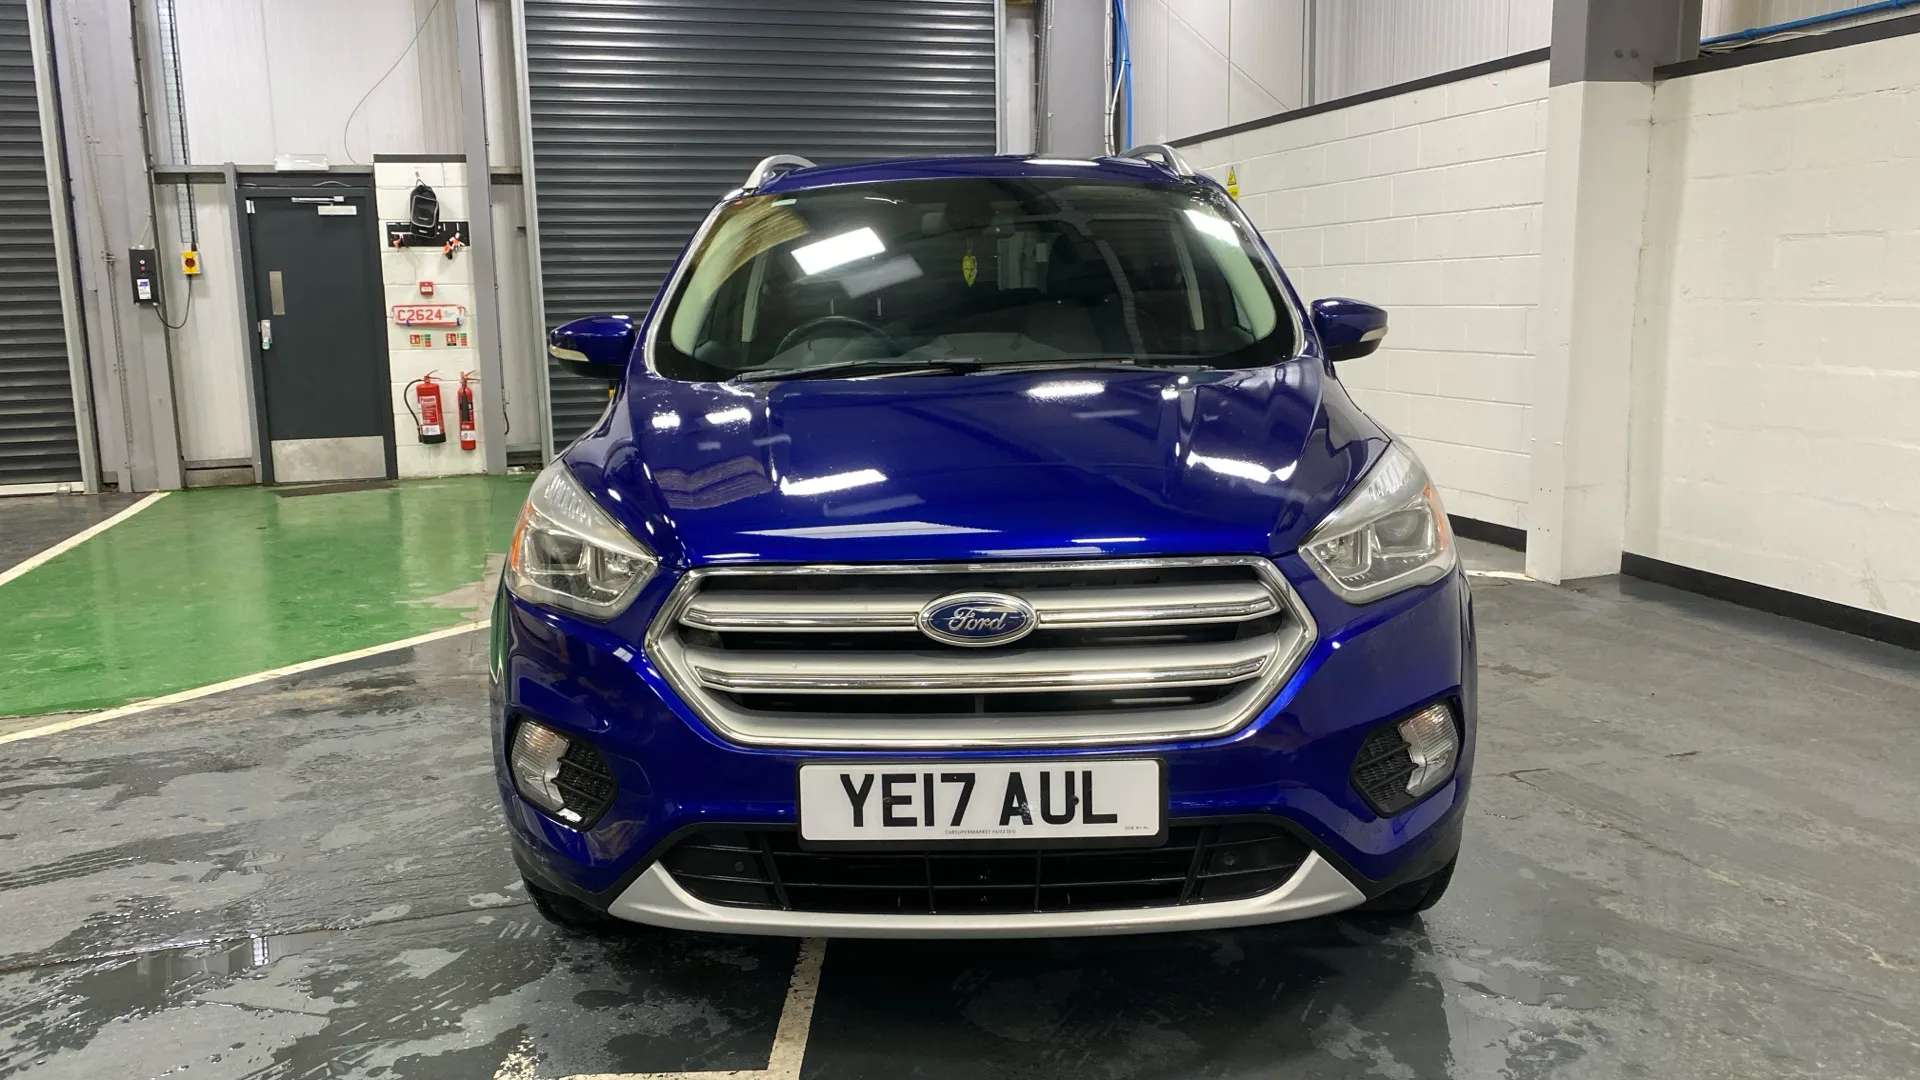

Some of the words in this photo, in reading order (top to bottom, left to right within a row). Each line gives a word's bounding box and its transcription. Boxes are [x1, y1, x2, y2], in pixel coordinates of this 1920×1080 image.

[947, 607, 1008, 631] Ford
[840, 772, 976, 827] YE17
[998, 770, 1118, 826] AUL
